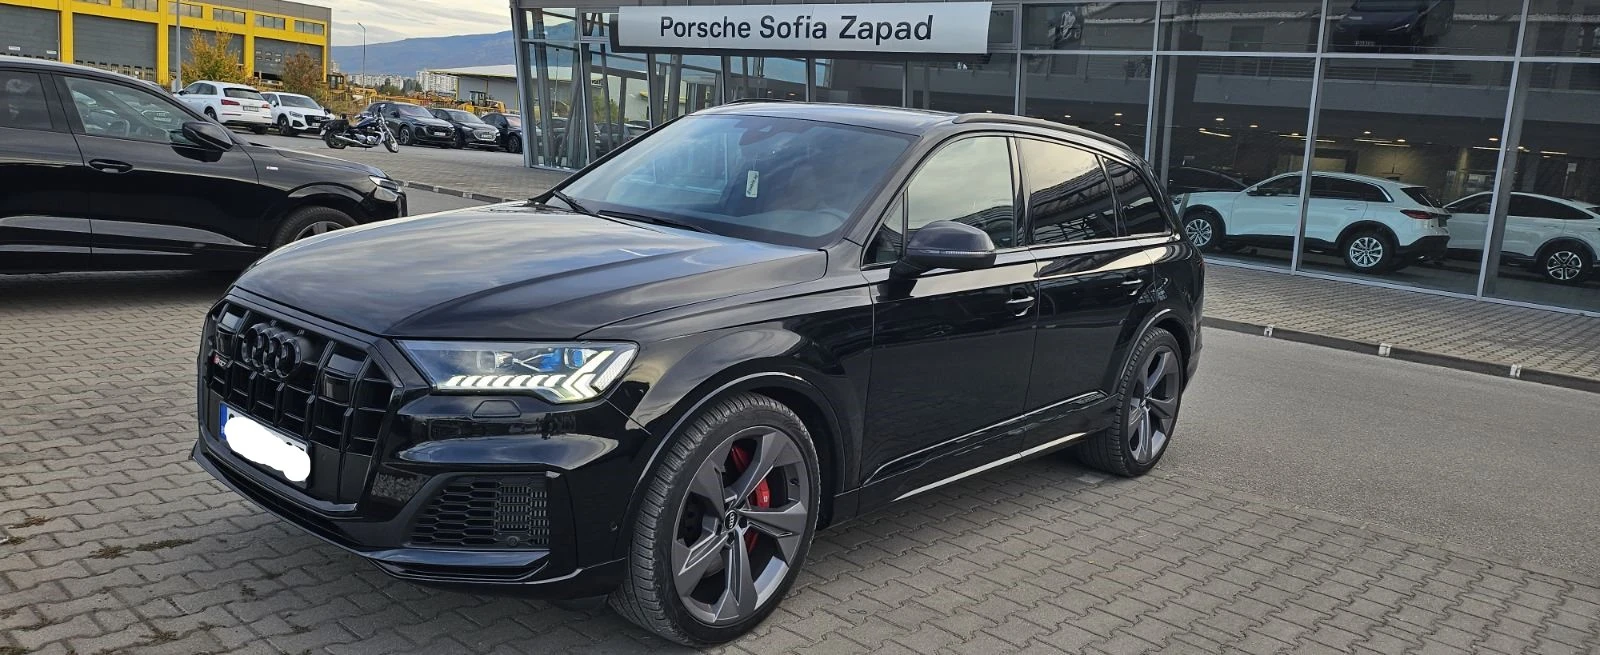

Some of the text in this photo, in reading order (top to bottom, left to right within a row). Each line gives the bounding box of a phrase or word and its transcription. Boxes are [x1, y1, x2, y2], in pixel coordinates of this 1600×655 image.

[660, 14, 934, 46] Porsche Sofia Zapad
